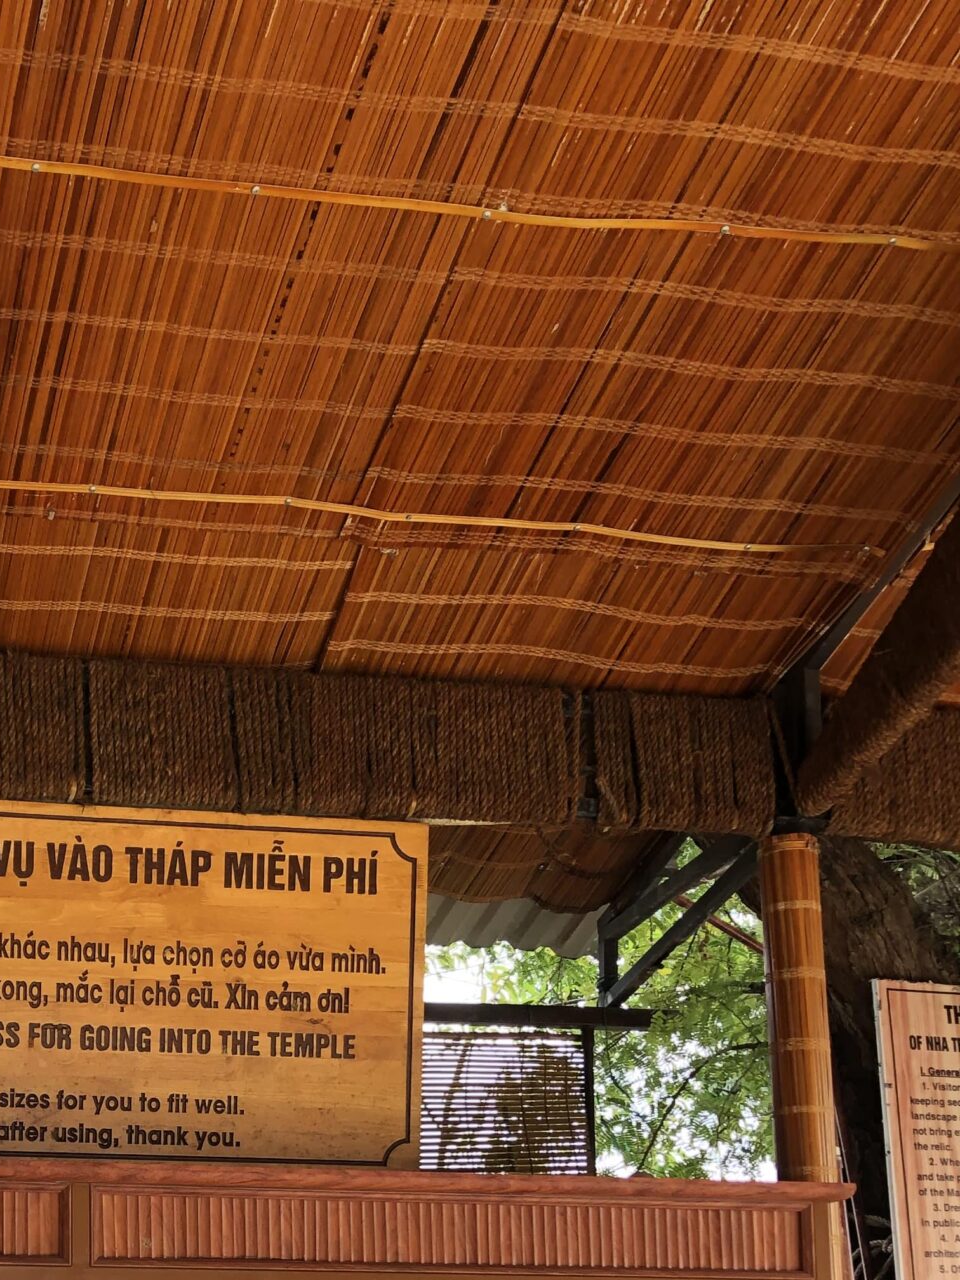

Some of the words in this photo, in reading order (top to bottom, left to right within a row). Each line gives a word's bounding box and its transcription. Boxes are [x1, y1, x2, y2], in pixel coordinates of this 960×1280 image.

[46, 835, 113, 883] VÀO
[125, 840, 213, 887] THÁP
[224, 840, 311, 892] MIỄN
[323, 850, 379, 895] PHÍ
[57, 935, 116, 968] nhau,
[123, 937, 156, 972] lựa
[162, 940, 214, 974] chọn
[253, 940, 280, 970] áo
[286, 942, 325, 972] vừa
[330, 944, 387, 975] mình.
[55, 969, 103, 1005] mắc
[109, 978, 135, 1013] lại
[265, 980, 312, 1013] cảm
[27, 1022, 72, 1050] FOR
[79, 1024, 152, 1053] GOING
[158, 1027, 212, 1055] INTO
[218, 1030, 261, 1057] THE
[267, 1031, 357, 1060] TEMPLE
[910, 1035, 923, 1051] OF
[927, 1036, 950, 1052] NHA
[56, 1089, 87, 1111] for
[92, 1094, 133, 1116] you
[139, 1092, 161, 1113] to
[166, 1093, 189, 1114] fit
[194, 1095, 246, 1116] well.
[910, 1097, 945, 1108] keeping
[911, 1112, 958, 1124] landscape
[54, 1122, 120, 1149] using,
[126, 1124, 190, 1147] thank
[194, 1130, 241, 1151] you.
[913, 1127, 927, 1136] not
[930, 1128, 953, 1138] bring
[914, 1142, 929, 1151] the
[917, 1172, 934, 1181] and
[937, 1172, 955, 1181] take
[919, 1188, 928, 1197] of
[931, 1188, 945, 1197] the
